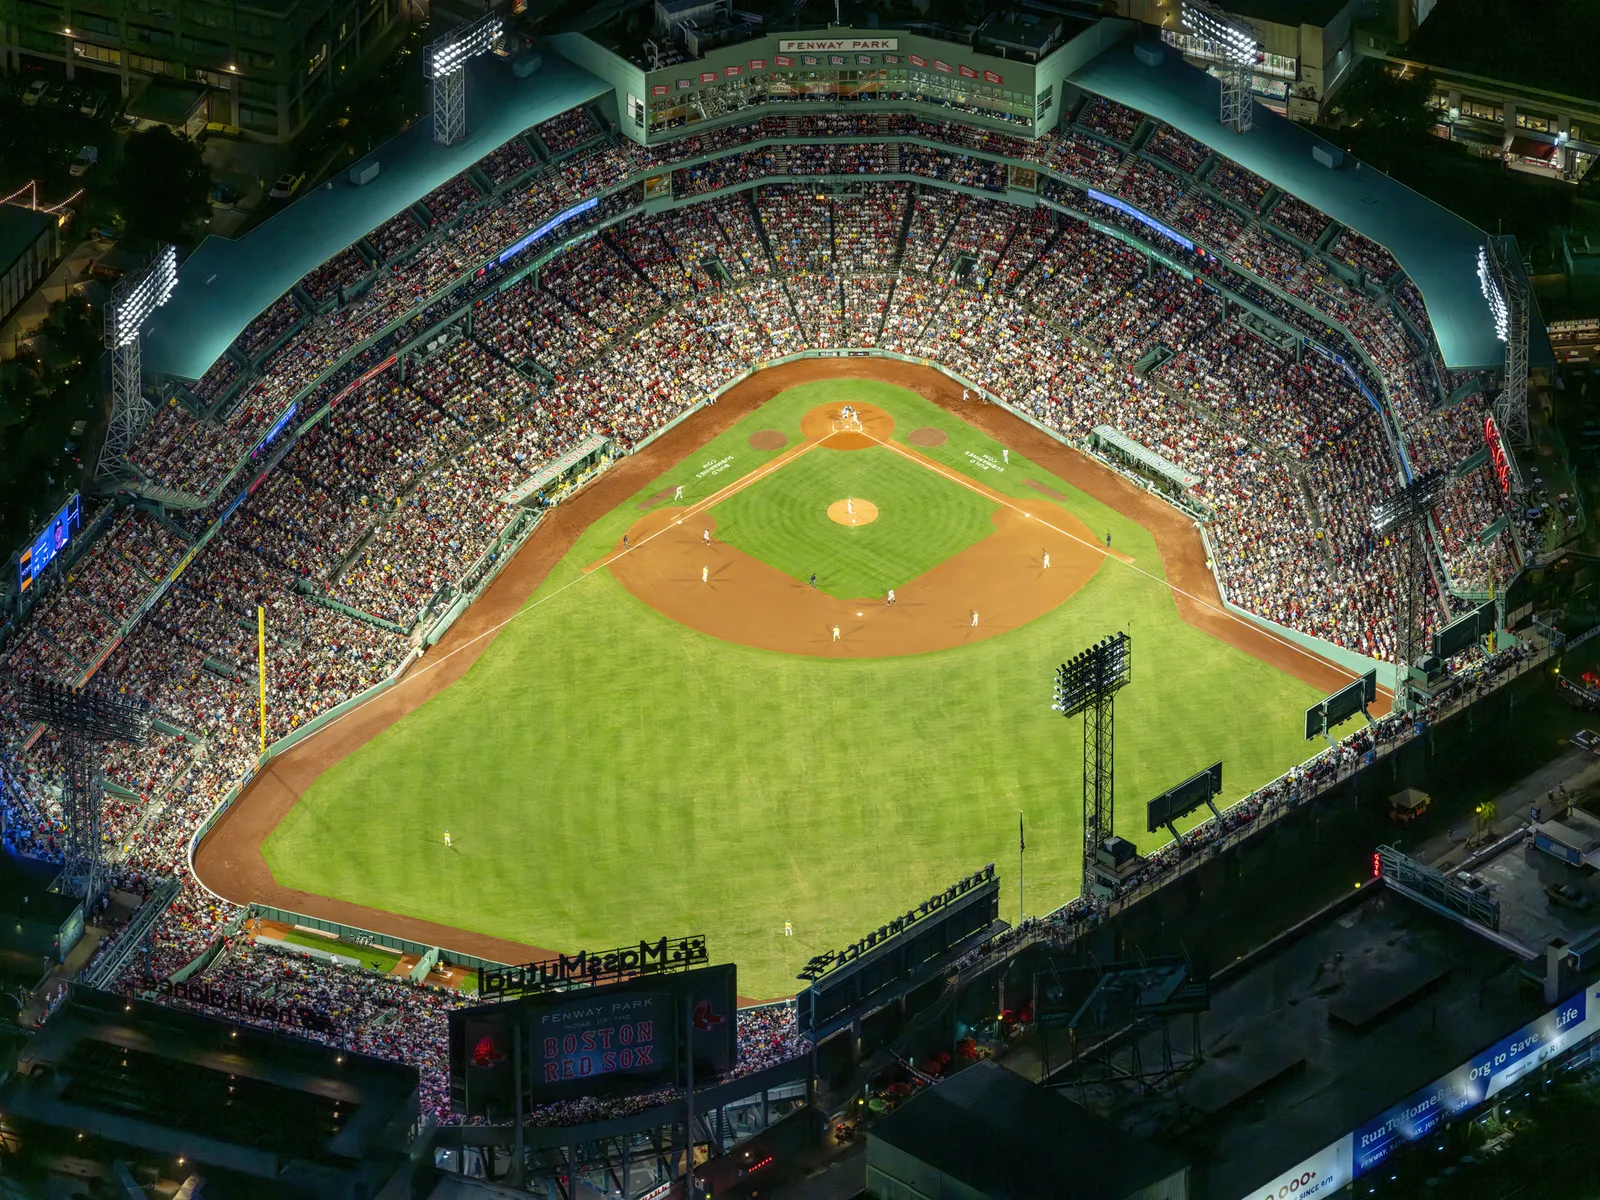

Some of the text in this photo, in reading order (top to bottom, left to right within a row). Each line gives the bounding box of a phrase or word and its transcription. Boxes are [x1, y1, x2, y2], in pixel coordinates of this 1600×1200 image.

[787, 40, 890, 51] FENWAY PARK
[696, 455, 734, 479] SUBMARINES
[711, 463, 731, 475] BUILD
[964, 450, 1005, 473] SUBMARINES
[969, 459, 989, 471] BUILD
[542, 998, 653, 1025] FENWAY PARK
[543, 1020, 654, 1059] BOSTON
[544, 1045, 654, 1083] RED SOX
[1361, 1061, 1491, 1148] RunToHomeBas.Org
[1494, 1052, 1507, 1066] to
[1509, 1032, 1539, 1057] Save
[1555, 1008, 1578, 1029] Life
[1424, 1117, 1439, 1132] JULY
[1452, 1099, 1469, 1113] 024
[1299, 1175, 1333, 1200] SINCE 9/11
